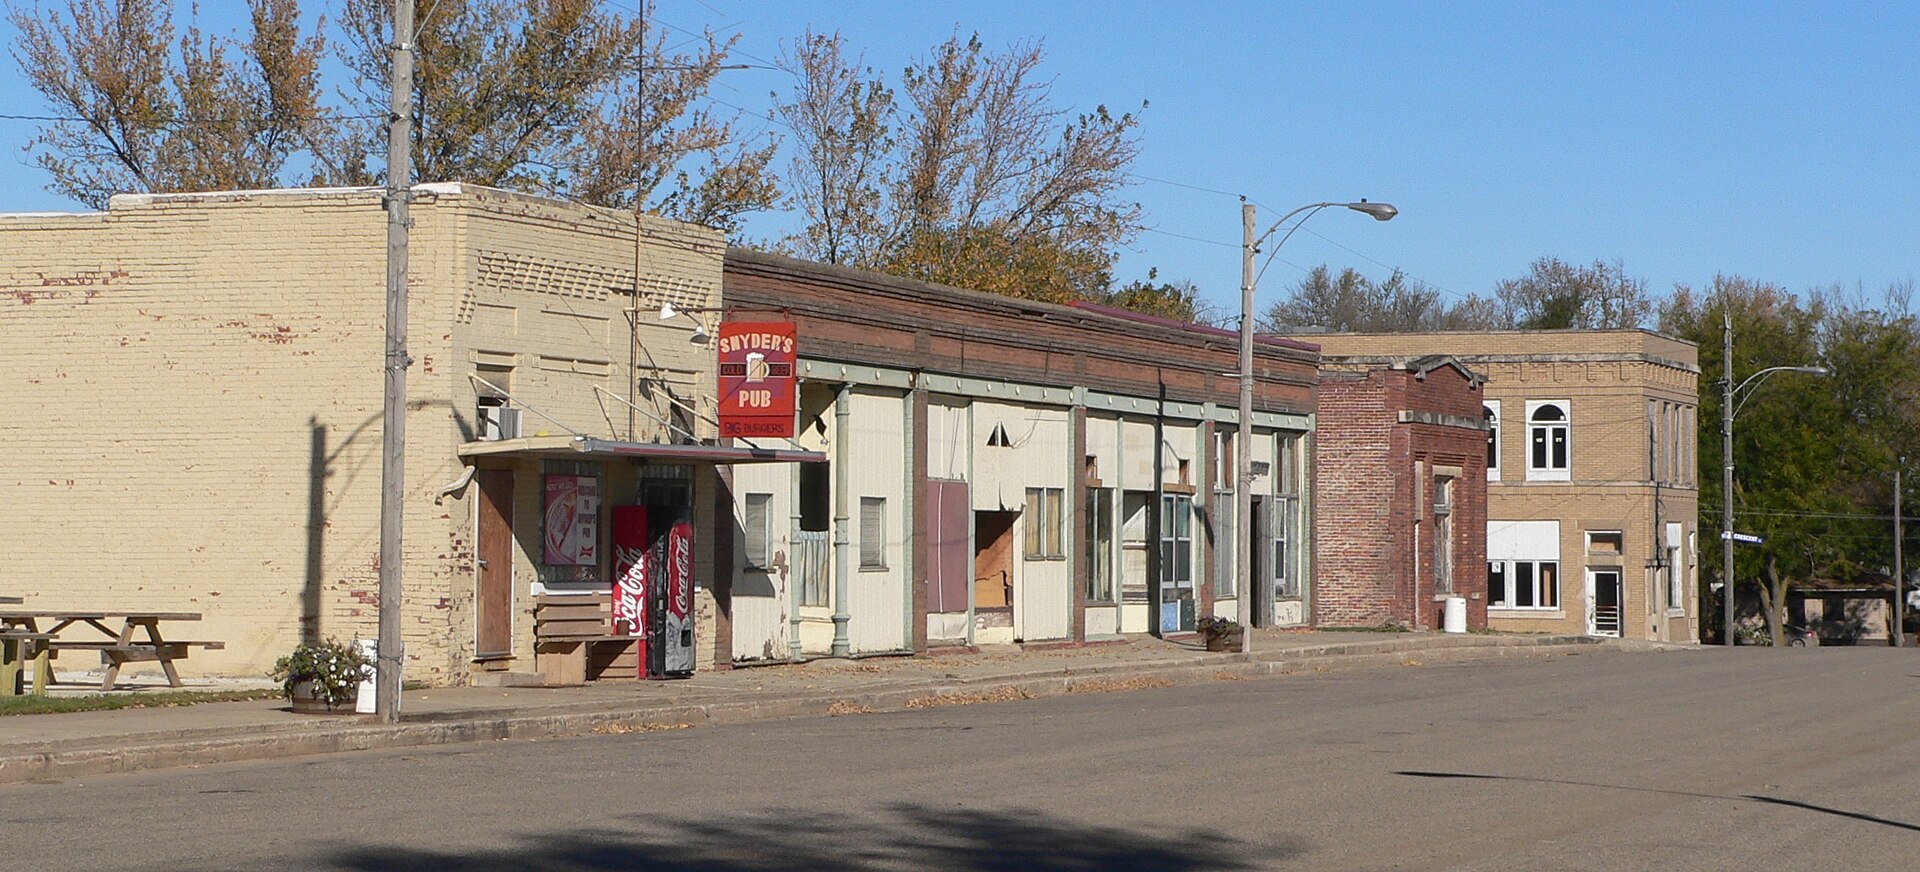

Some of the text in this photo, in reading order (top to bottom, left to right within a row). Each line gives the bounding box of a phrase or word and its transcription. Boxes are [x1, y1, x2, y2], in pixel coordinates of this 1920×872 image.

[720, 333, 794, 353] SNYDER'S
[721, 364, 744, 376] COLD
[738, 390, 772, 408] PUB
[724, 422, 785, 434] BIG BURGERS
[675, 534, 689, 614] Coca-Cola
